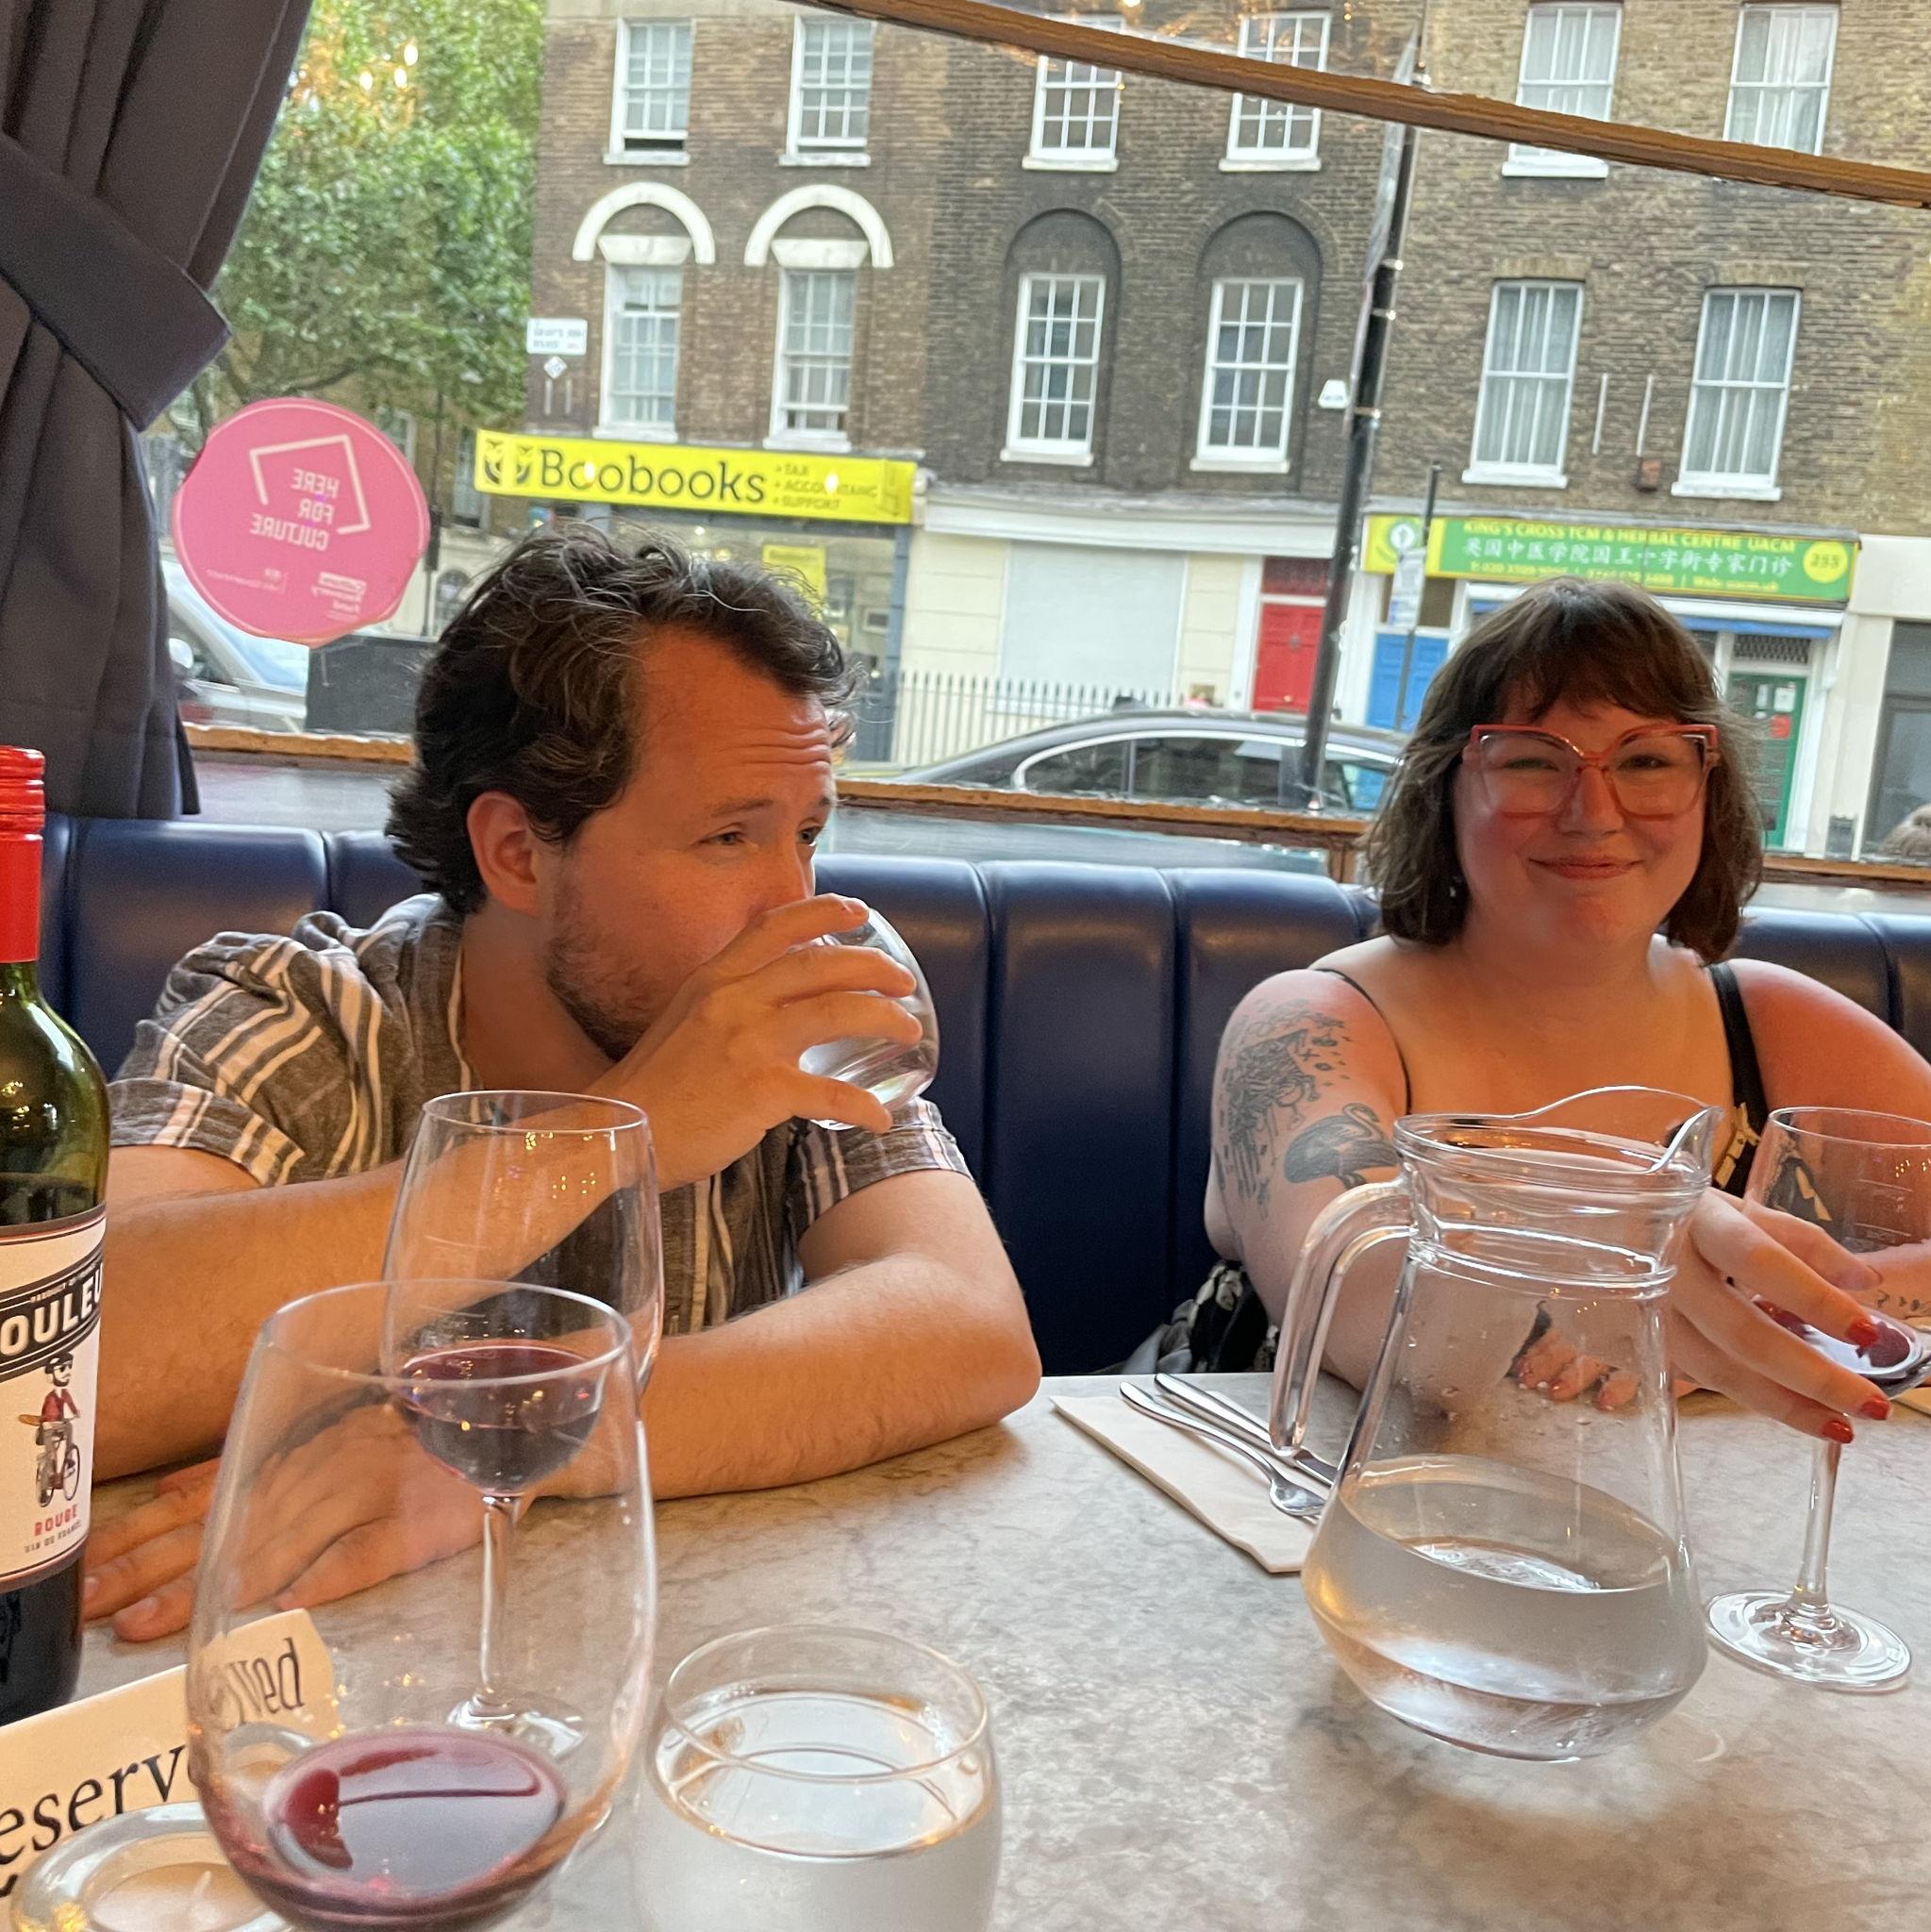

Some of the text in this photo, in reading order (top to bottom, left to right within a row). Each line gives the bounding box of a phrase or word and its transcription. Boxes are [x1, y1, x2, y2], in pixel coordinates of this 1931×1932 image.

[541, 449, 765, 503] Boobooks
[1464, 521, 1510, 537] KING'S
[1516, 522, 1564, 540] CROSS
[1569, 524, 1600, 541] TCM
[1618, 528, 1678, 546] HERBAL
[1682, 532, 1742, 551] CENTRE
[34, 1504, 77, 1537] ROUGE
